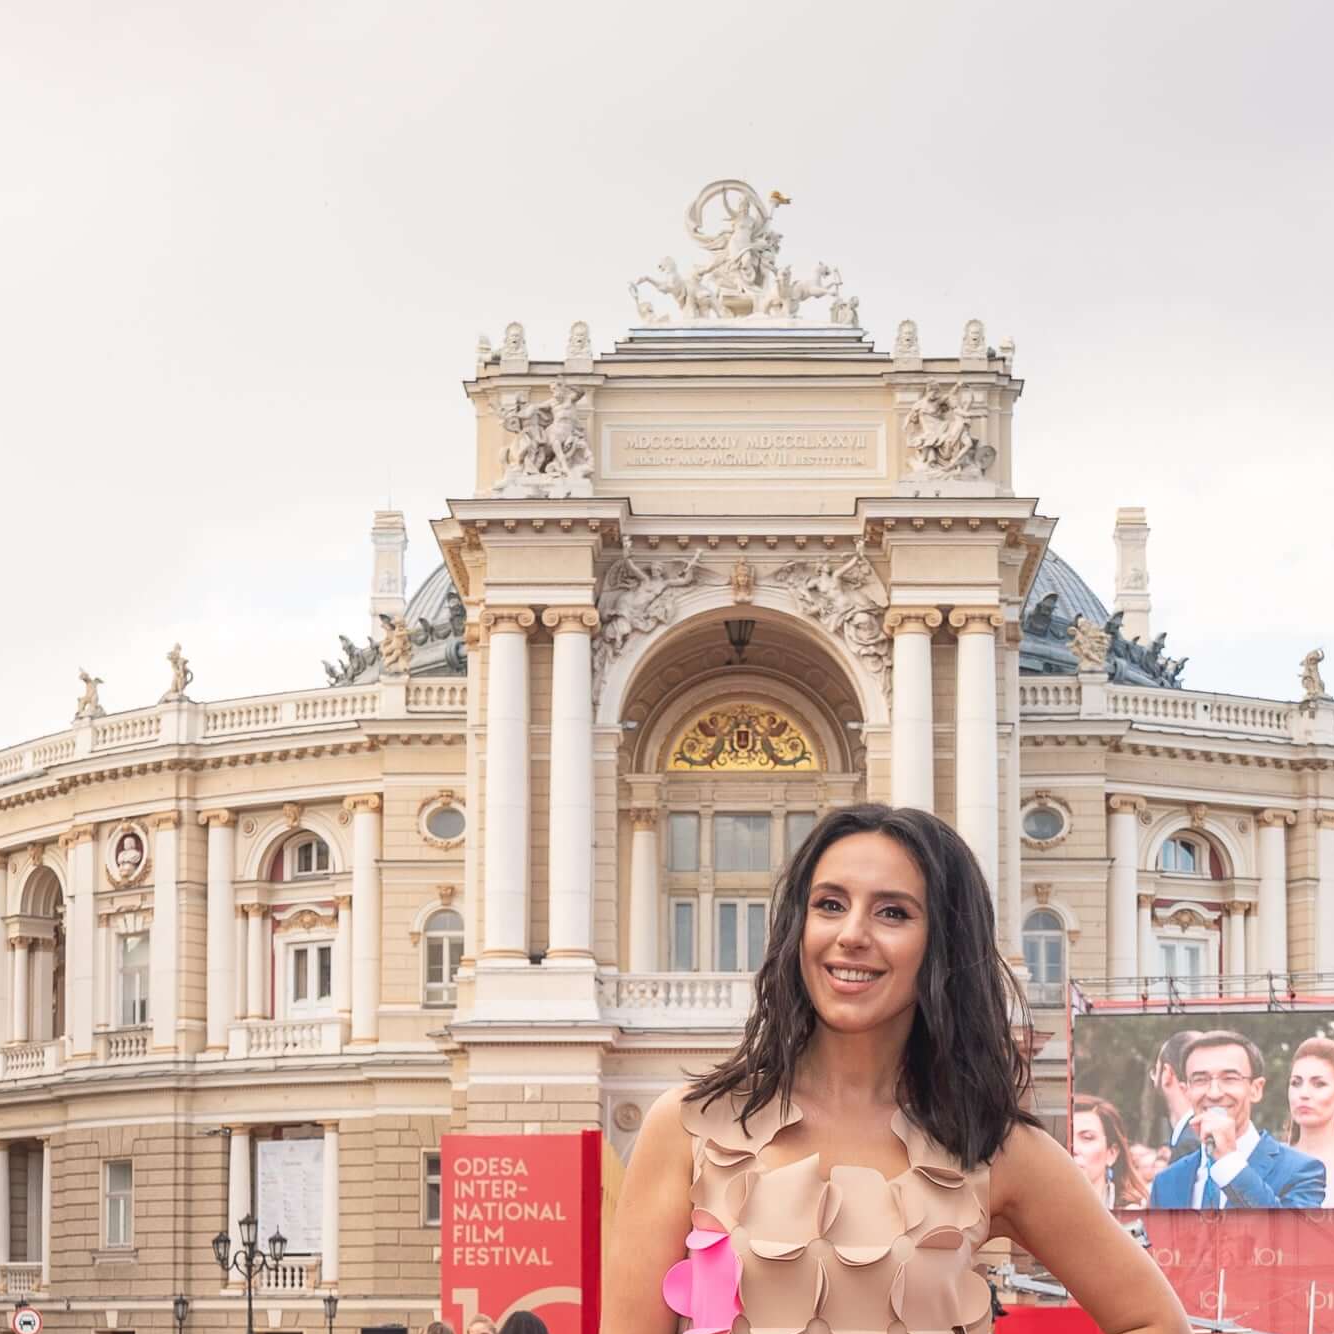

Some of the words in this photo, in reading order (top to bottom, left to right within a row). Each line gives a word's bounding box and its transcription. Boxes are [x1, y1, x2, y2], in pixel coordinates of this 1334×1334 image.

[453, 1157, 528, 1176] ODESA
[454, 1179, 528, 1199] INTER-
[453, 1201, 566, 1221] NATIONAL
[453, 1224, 504, 1243] FILM
[453, 1246, 553, 1266] FESTIVAL
